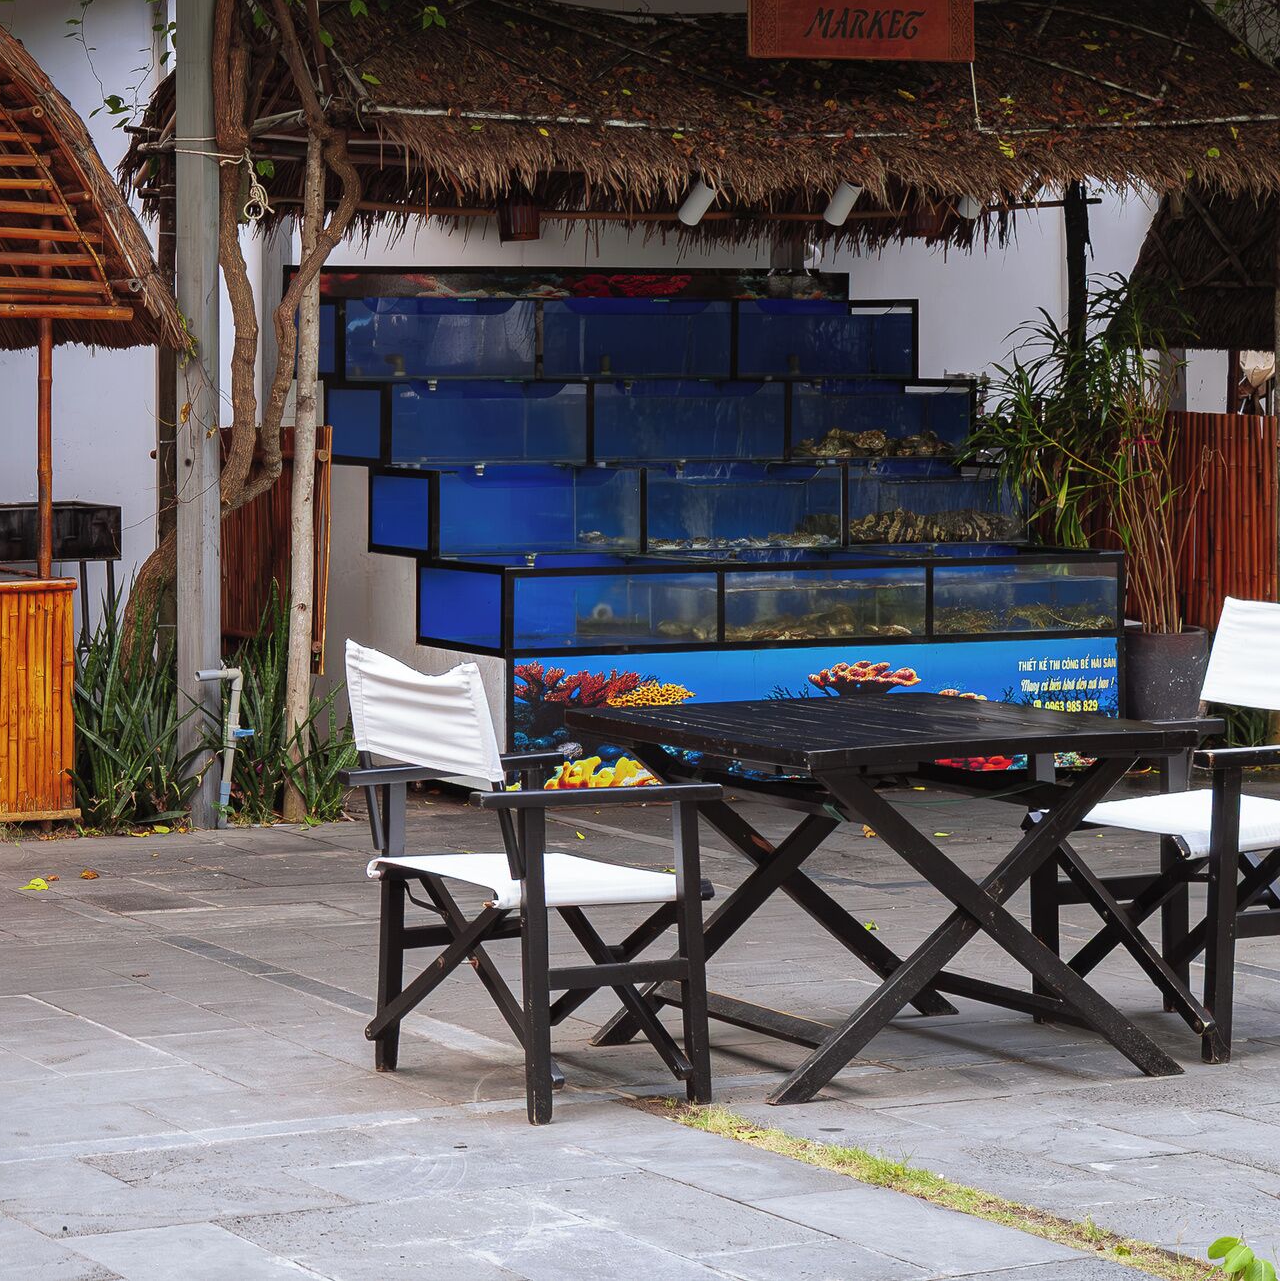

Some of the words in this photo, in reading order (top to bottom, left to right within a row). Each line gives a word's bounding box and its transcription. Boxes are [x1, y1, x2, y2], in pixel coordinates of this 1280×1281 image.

[803, 6, 927, 41] MARKET
[1049, 660, 1060, 670] THI
[1066, 700, 1081, 712] 985
[1083, 699, 1099, 712] 829
